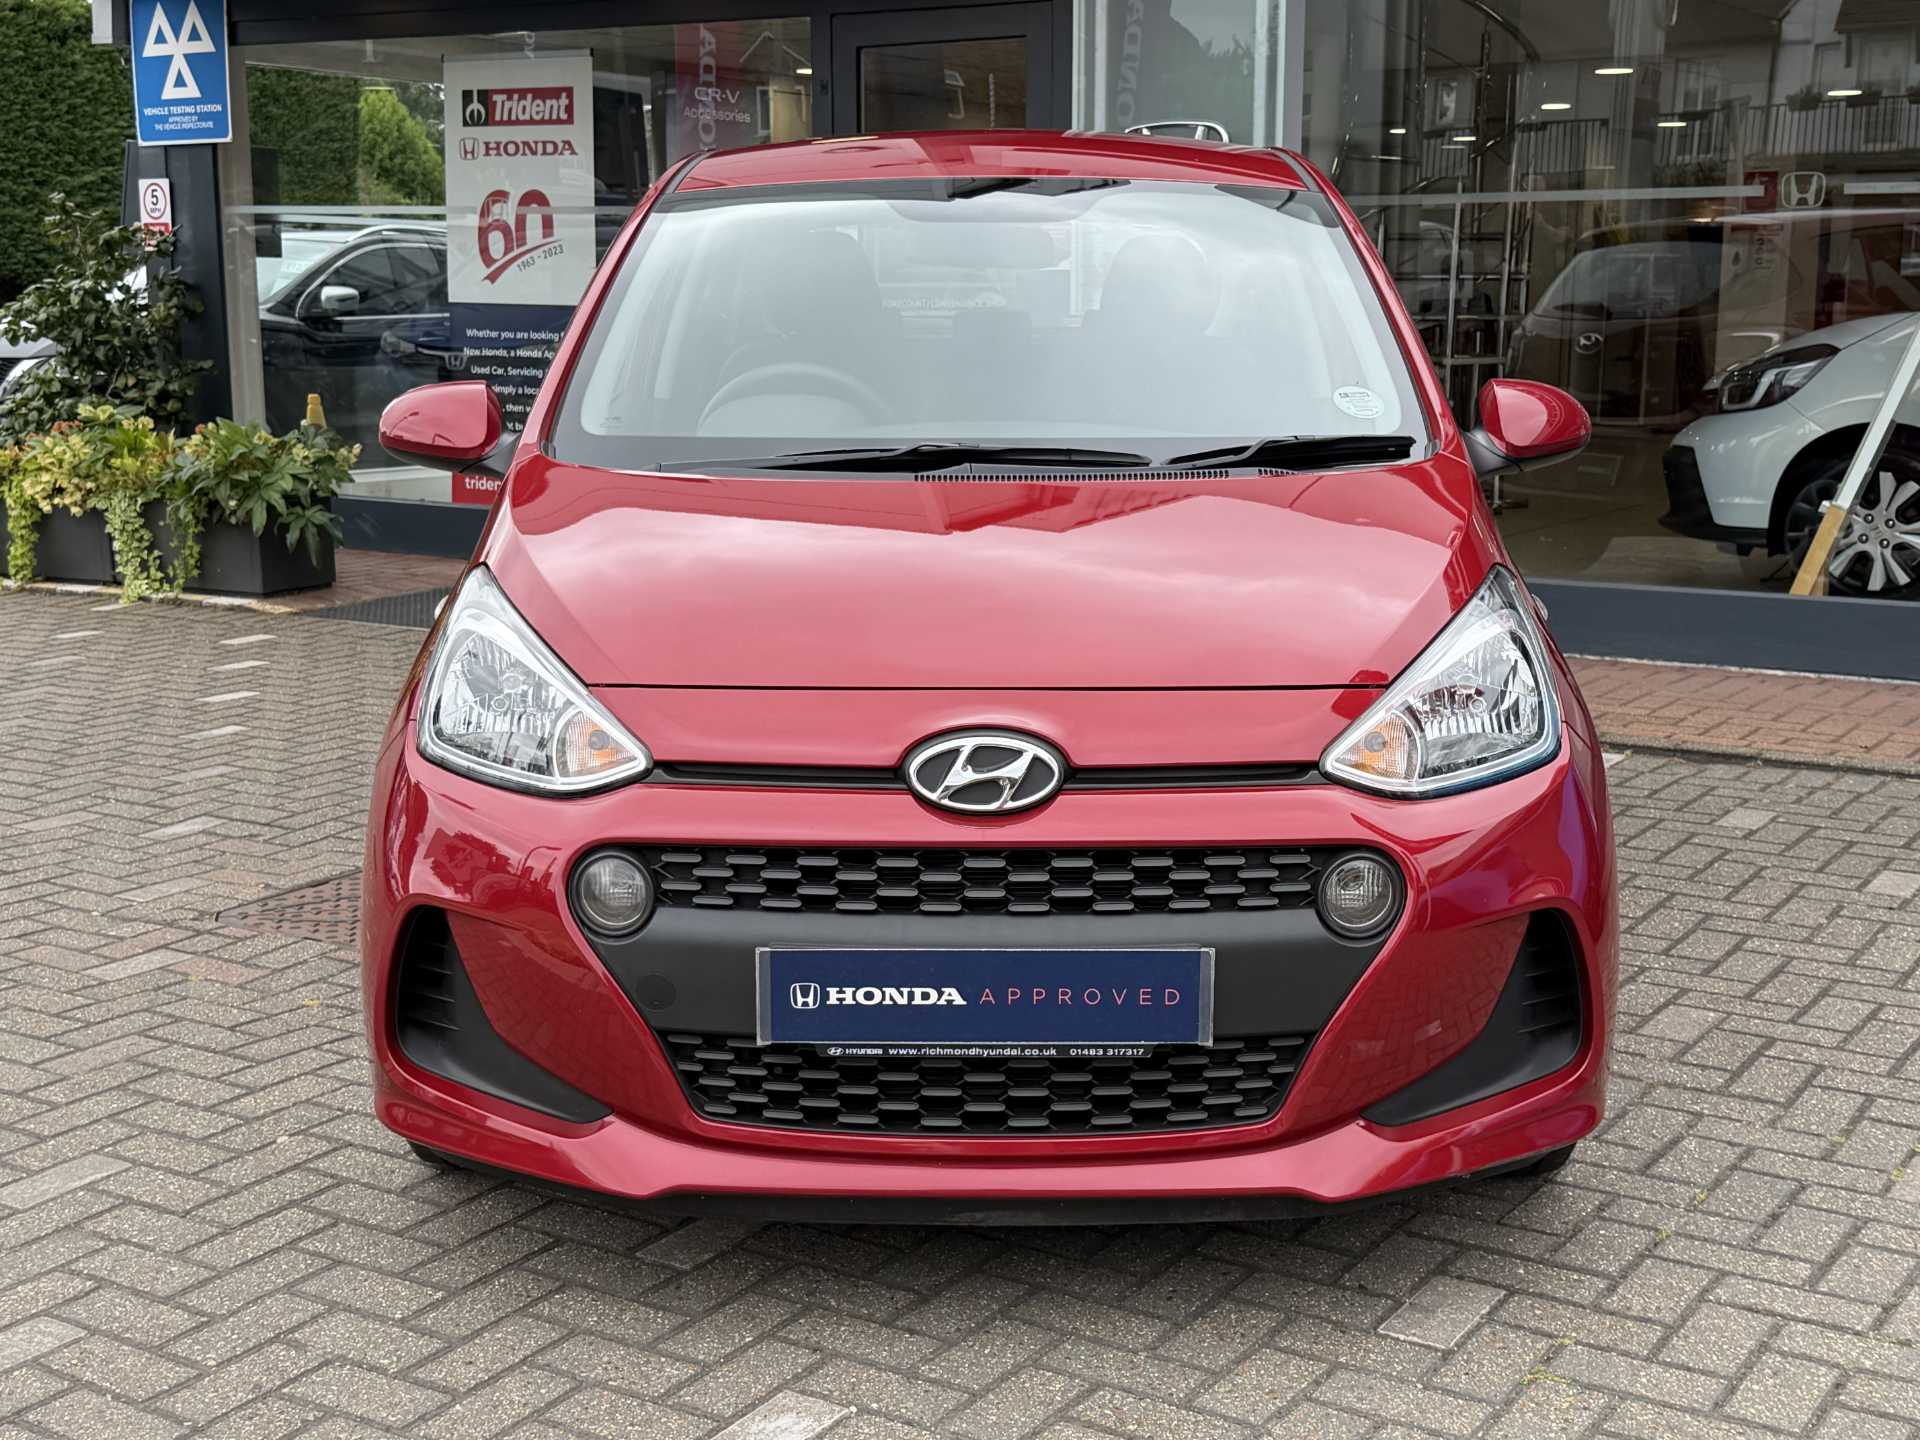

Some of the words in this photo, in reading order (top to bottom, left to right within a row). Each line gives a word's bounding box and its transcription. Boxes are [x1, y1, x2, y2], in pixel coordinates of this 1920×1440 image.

[144, 106, 169, 116] VEHICLE
[170, 105, 195, 114] TESTING
[197, 104, 222, 113] STATION
[492, 92, 569, 121] Trident
[683, 107, 751, 123] Accessories
[482, 140, 578, 157] HONDA
[151, 189, 159, 206] 5
[516, 255, 536, 272] 1963
[543, 244, 564, 260] 2023
[466, 328, 499, 338] Whether
[500, 331, 515, 340] you
[516, 331, 529, 339] are
[530, 329, 559, 341] looking
[463, 347, 480, 356] New
[481, 347, 509, 358] Honda,
[516, 348, 542, 358] Honda
[470, 366, 490, 375] Used
[491, 366, 507, 376] Car,
[507, 366, 543, 378] Servicing
[491, 384, 517, 396] simply
[506, 404, 524, 413] then
[826, 986, 967, 1006] HONDA
[979, 987, 1181, 1006] APPROVED
[888, 1047, 1057, 1057] www.richmondhyundai.co.uk
[1070, 1048, 1103, 1056] 01483
[1106, 1048, 1145, 1056] 317317
